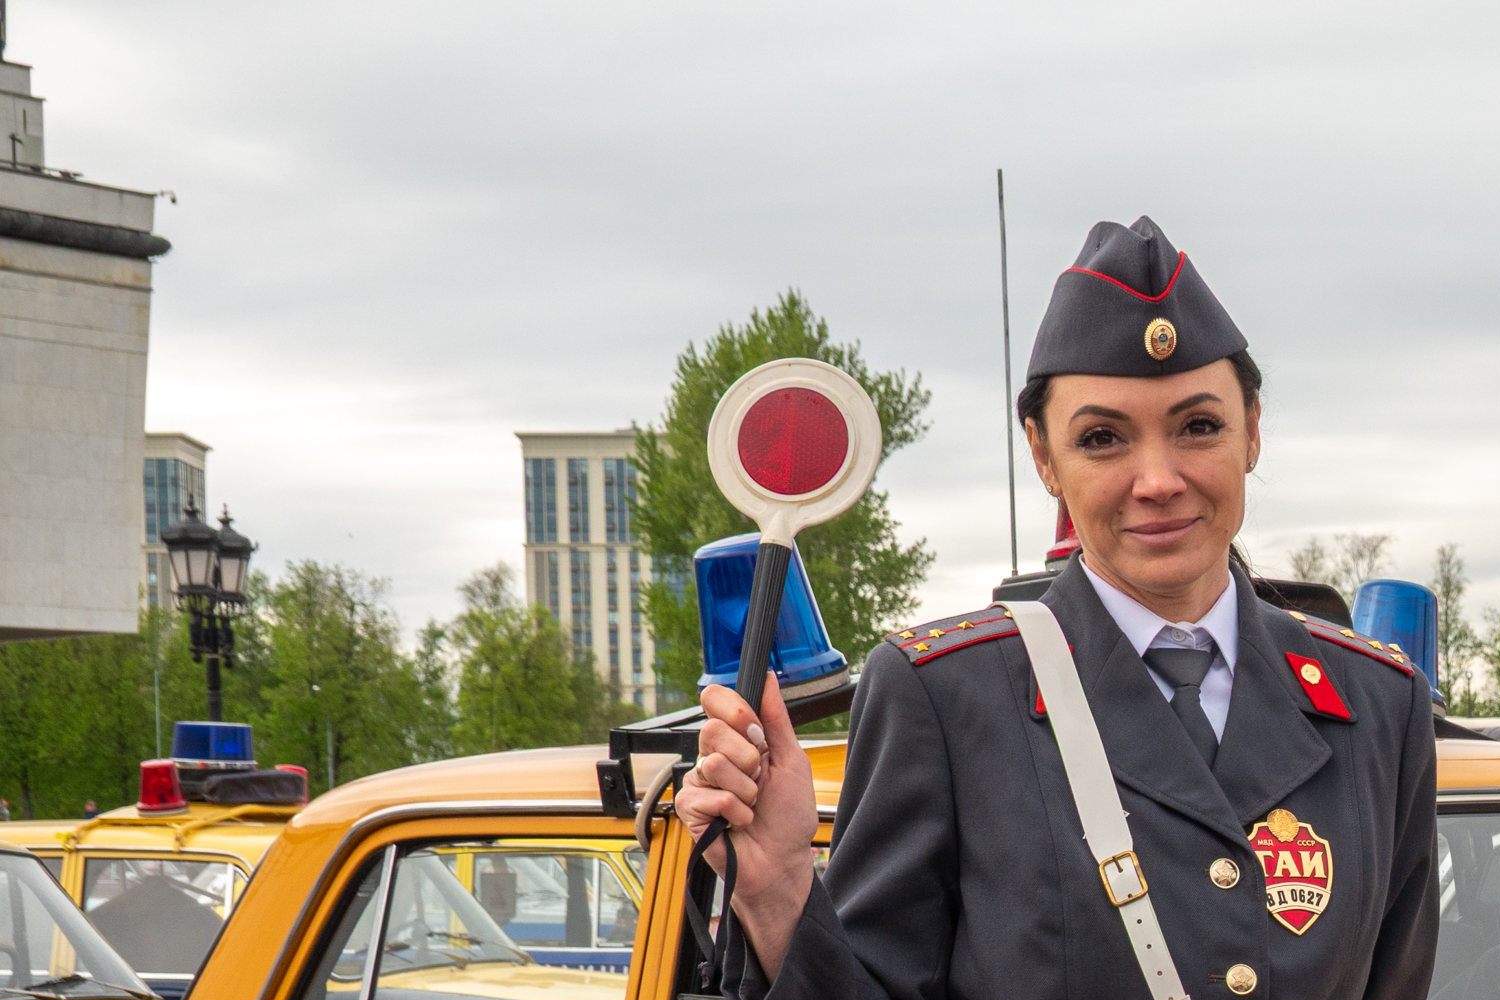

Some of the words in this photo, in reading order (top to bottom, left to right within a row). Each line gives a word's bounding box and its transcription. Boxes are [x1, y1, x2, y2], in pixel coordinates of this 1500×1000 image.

[1257, 838, 1274, 847] МВД
[1296, 839, 1316, 847] СССР
[1255, 850, 1328, 879] ГАИ
[1290, 888, 1324, 907] 0627
